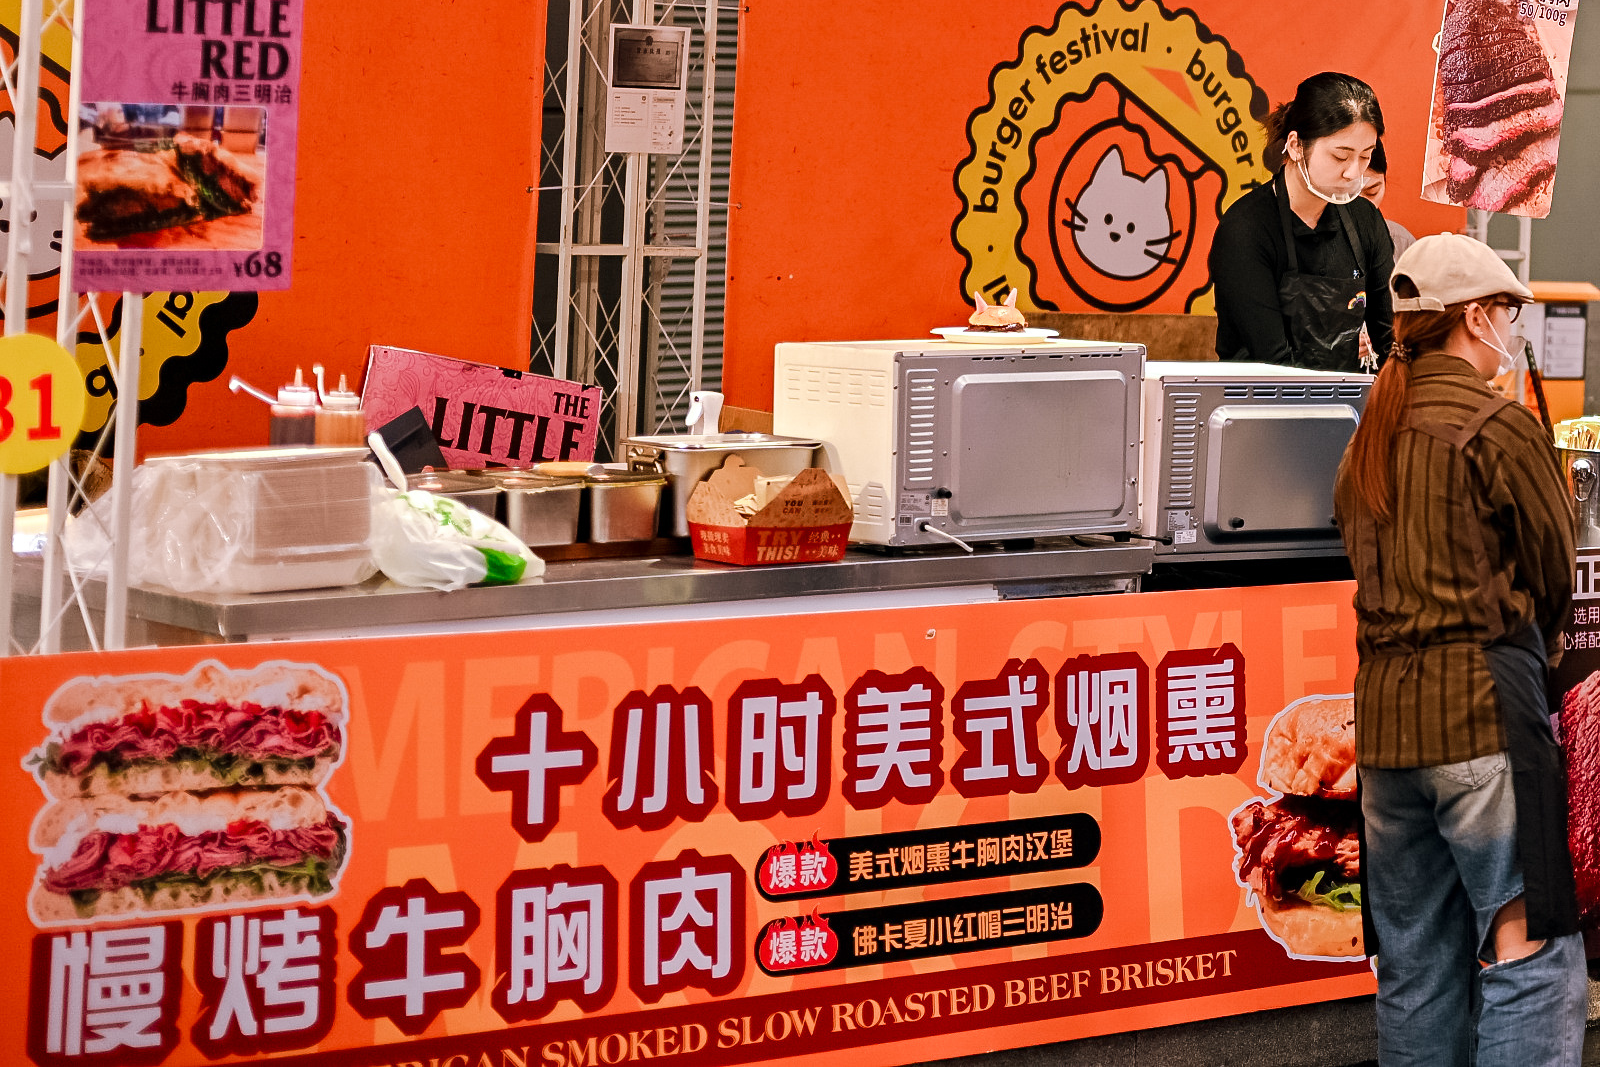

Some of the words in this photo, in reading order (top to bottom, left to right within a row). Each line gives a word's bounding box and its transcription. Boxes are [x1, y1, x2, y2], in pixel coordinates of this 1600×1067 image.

[1519, 0, 1568, 27] 50/100g
[200, 40, 290, 81] RED
[171, 81, 292, 104] 牛胸肉三明治
[973, 78, 1036, 214] burger
[1034, 21, 1151, 85] festival
[1185, 48, 1255, 168] burger
[233, 251, 283, 278] ¥68
[433, 396, 585, 463] LITTLE
[552, 390, 590, 420] THE
[756, 545, 800, 562] THIS!
[757, 530, 804, 546] TRY
[490, 656, 1239, 824] 十小时美式烟熏
[768, 849, 829, 890] 爆款
[848, 828, 1074, 882] 美式烟熏牛胸肉汉堡
[768, 925, 829, 966] 爆款
[852, 900, 1074, 956] 佛卡夏小红帽三明治
[45, 867, 733, 1057] 慢烤牛胸肉
[540, 1019, 708, 1067] SMOKED
[717, 1003, 824, 1047] SLOW
[831, 982, 997, 1033] ROASTED
[1003, 968, 1091, 1008] BEEF
[1099, 948, 1239, 996] BRISKET
